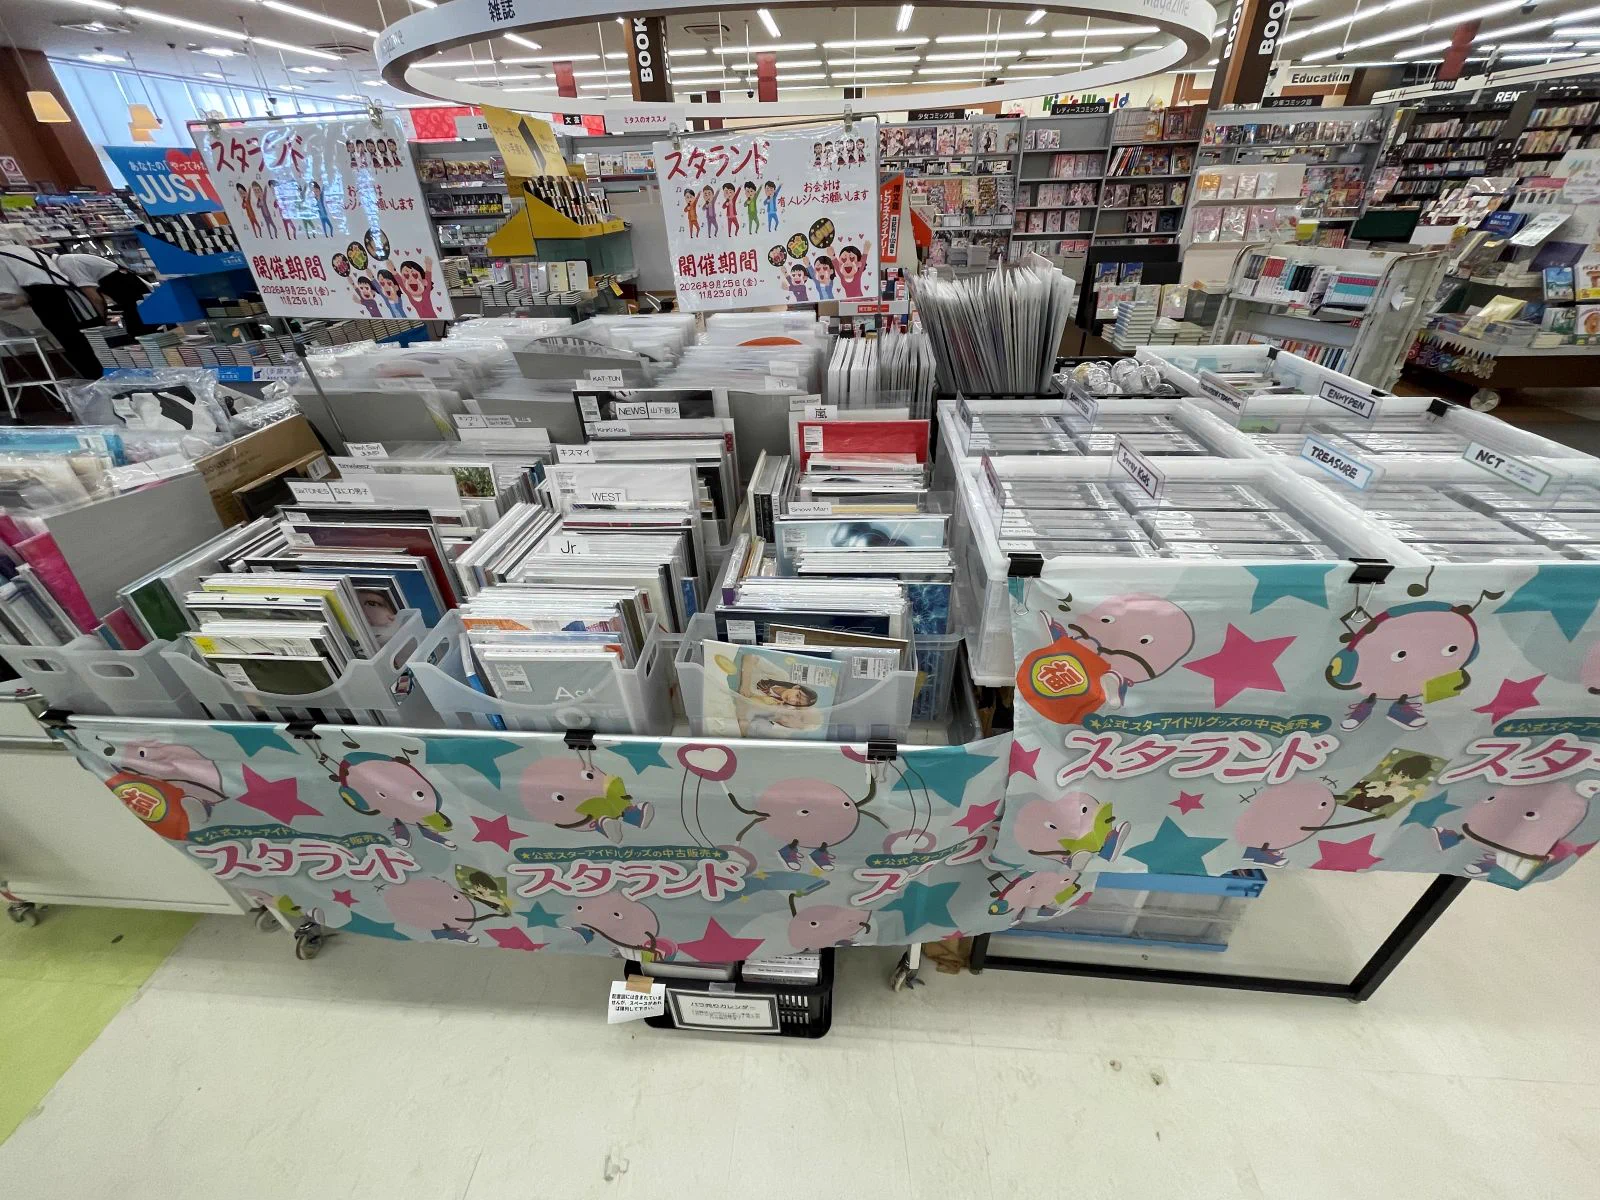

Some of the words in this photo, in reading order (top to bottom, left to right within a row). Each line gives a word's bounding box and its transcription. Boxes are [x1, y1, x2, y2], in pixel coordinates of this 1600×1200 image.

[633, 17, 654, 82] BOOK
[1291, 72, 1350, 84] Education
[623, 115, 668, 124] ミタスのオススメ
[664, 141, 771, 180] スタランド
[136, 173, 210, 205] JUST
[803, 179, 841, 193] お会計は
[252, 255, 327, 282] 開催期間
[677, 249, 758, 278] 開催期間
[618, 406, 647, 416] NEWS
[1327, 388, 1365, 411] ENHYPEN
[559, 447, 591, 457] キスマイ
[1311, 446, 1357, 480] TREASURE
[1475, 449, 1506, 469] NCT
[1137, 465, 1151, 487] Kids
[560, 540, 581, 555] Jr.
[1060, 734, 1332, 781] スタランド
[1445, 738, 1600, 781] スタ
[193, 840, 418, 881] スタランド
[512, 861, 742, 899] スタランド
